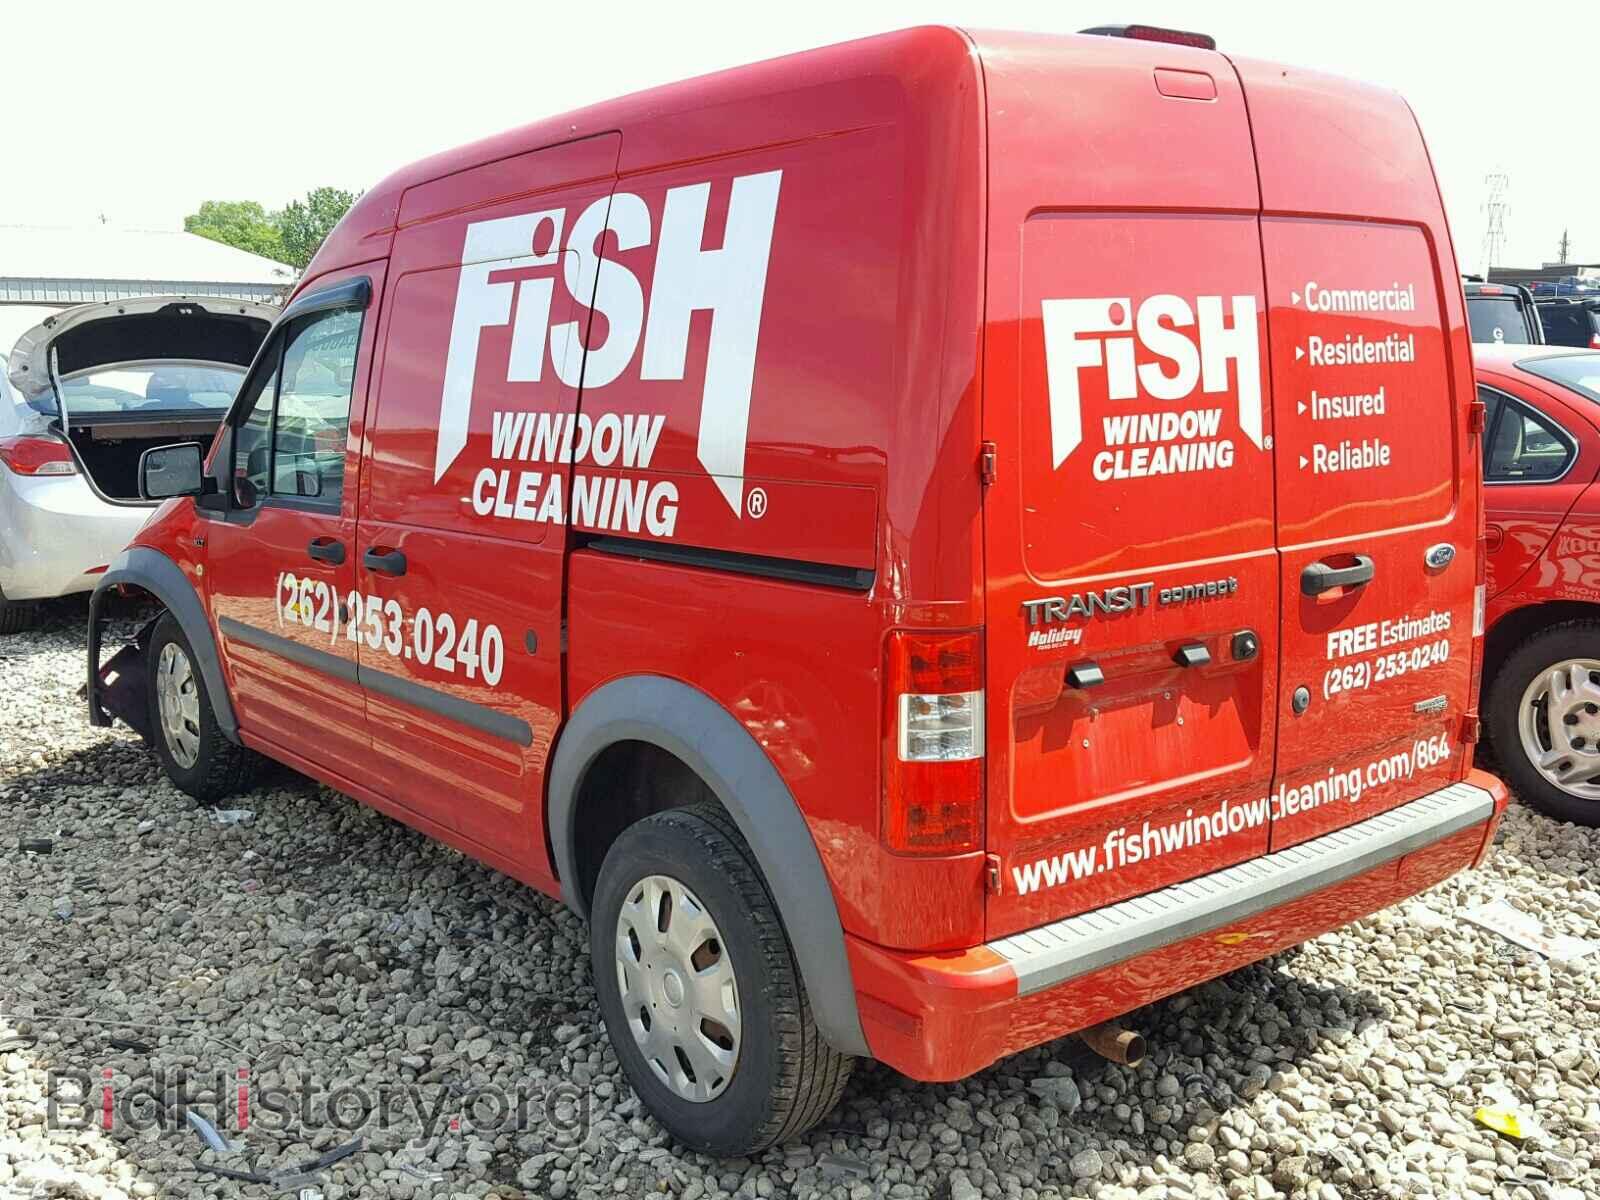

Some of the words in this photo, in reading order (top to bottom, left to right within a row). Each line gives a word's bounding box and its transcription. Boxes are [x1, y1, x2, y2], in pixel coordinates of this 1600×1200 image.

[1304, 281, 1415, 314] Commercial
[1308, 333, 1415, 367] Residential
[1311, 386, 1386, 421] Insured
[490, 411, 665, 469] WINDOW
[1102, 408, 1223, 447] WINDOW
[1092, 440, 1235, 482] CLEANING
[1312, 438, 1391, 475] Reliable
[471, 467, 680, 537] CLEANING
[1022, 581, 1155, 626] TRANSIT
[1159, 576, 1239, 606] connect
[276, 571, 340, 646] (262)
[346, 590, 504, 687] 253.0240
[1028, 627, 1083, 646] Holiday
[1327, 623, 1378, 660] FREE
[1381, 609, 1451, 648] Estimates
[1323, 660, 1371, 700] (262)
[1374, 639, 1450, 682] 253-0240
[1012, 731, 1450, 896] www.fishwindowcleaning.com/864
